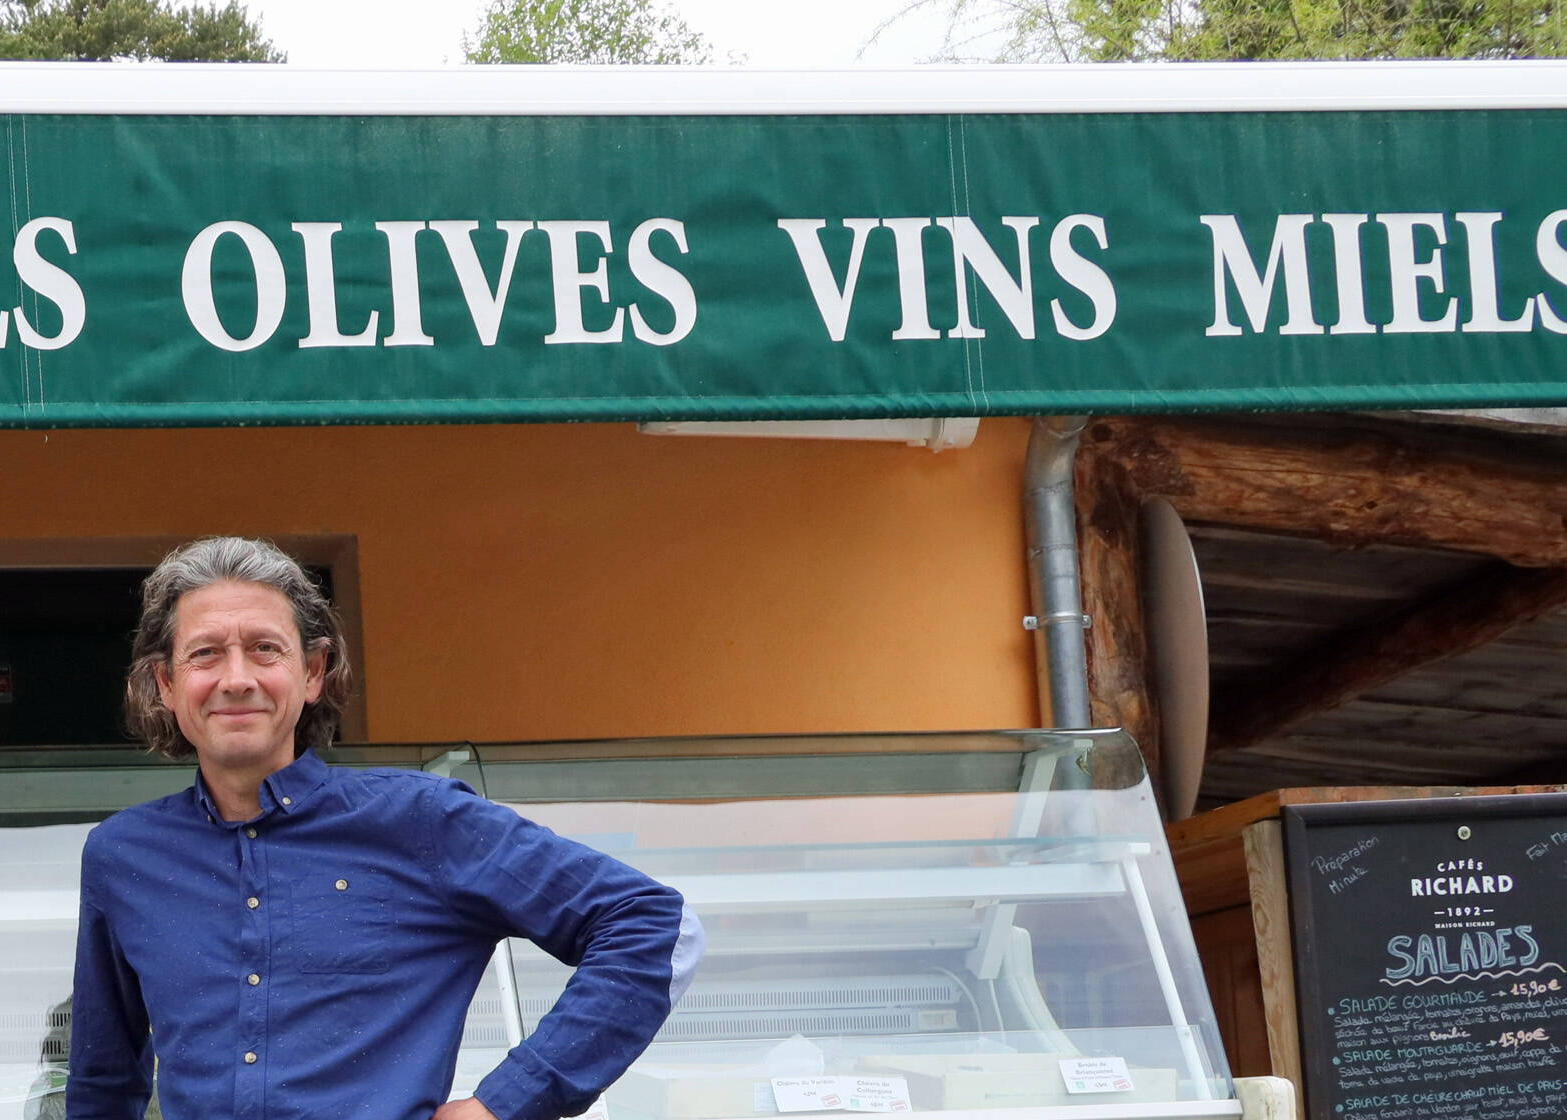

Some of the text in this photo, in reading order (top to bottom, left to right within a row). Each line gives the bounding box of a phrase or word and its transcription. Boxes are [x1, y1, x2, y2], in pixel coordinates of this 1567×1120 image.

[180, 217, 698, 352] OLIVES
[777, 213, 1117, 343] VINS
[1199, 210, 1567, 338] MIELS
[1437, 858, 1483, 872] CAFÉS
[1327, 867, 1369, 895] Minute
[1411, 875, 1514, 896] RICHARD
[1385, 925, 1539, 979] SALADES
[1339, 995, 1398, 1015] SALADE
[1402, 991, 1488, 1009] GOURMANDE
[1343, 1049, 1393, 1063] SALADE
[1345, 1095, 1391, 1110] SALADE
[1392, 1094, 1410, 1104] DE
[1517, 1083, 1535, 1093] DE
